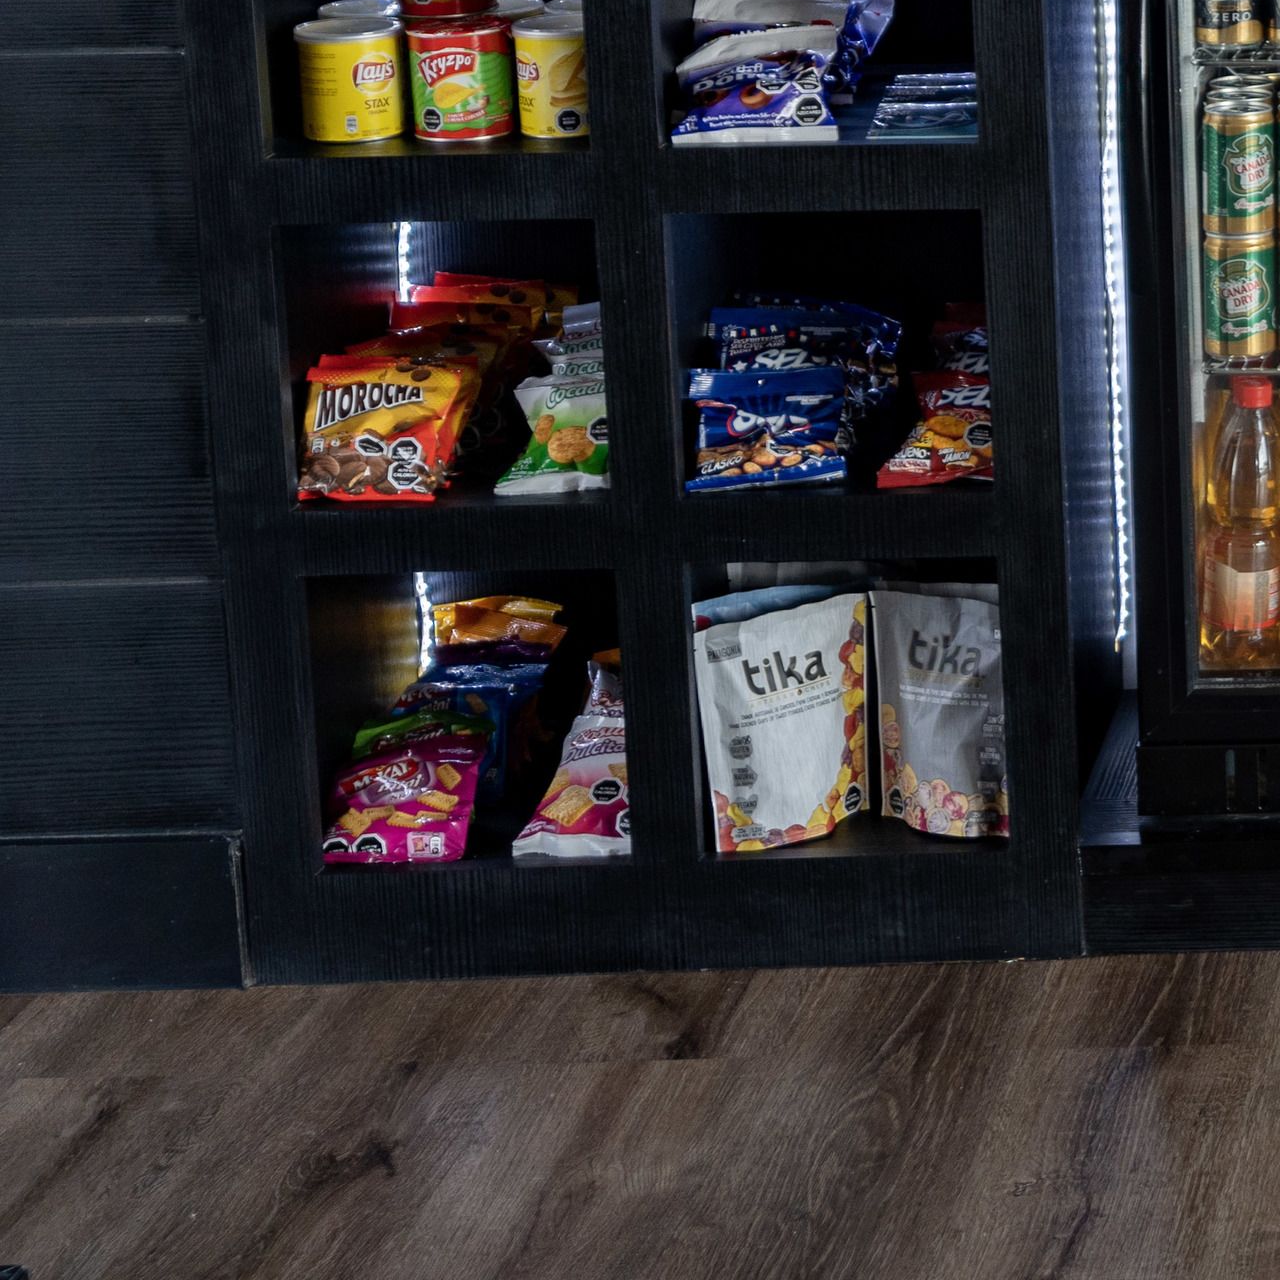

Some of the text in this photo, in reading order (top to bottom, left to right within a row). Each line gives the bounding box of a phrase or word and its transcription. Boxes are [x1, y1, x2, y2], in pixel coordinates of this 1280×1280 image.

[1211, 12, 1251, 22] ZERO
[421, 54, 472, 84] Kryzpo
[365, 97, 390, 110] STAX
[1248, 169, 1267, 182] DRY
[1221, 279, 1262, 298] CANADA
[1233, 293, 1255, 308] DRY
[314, 382, 423, 430] MOROCHA
[909, 629, 981, 677] tika
[742, 650, 828, 696] tika
